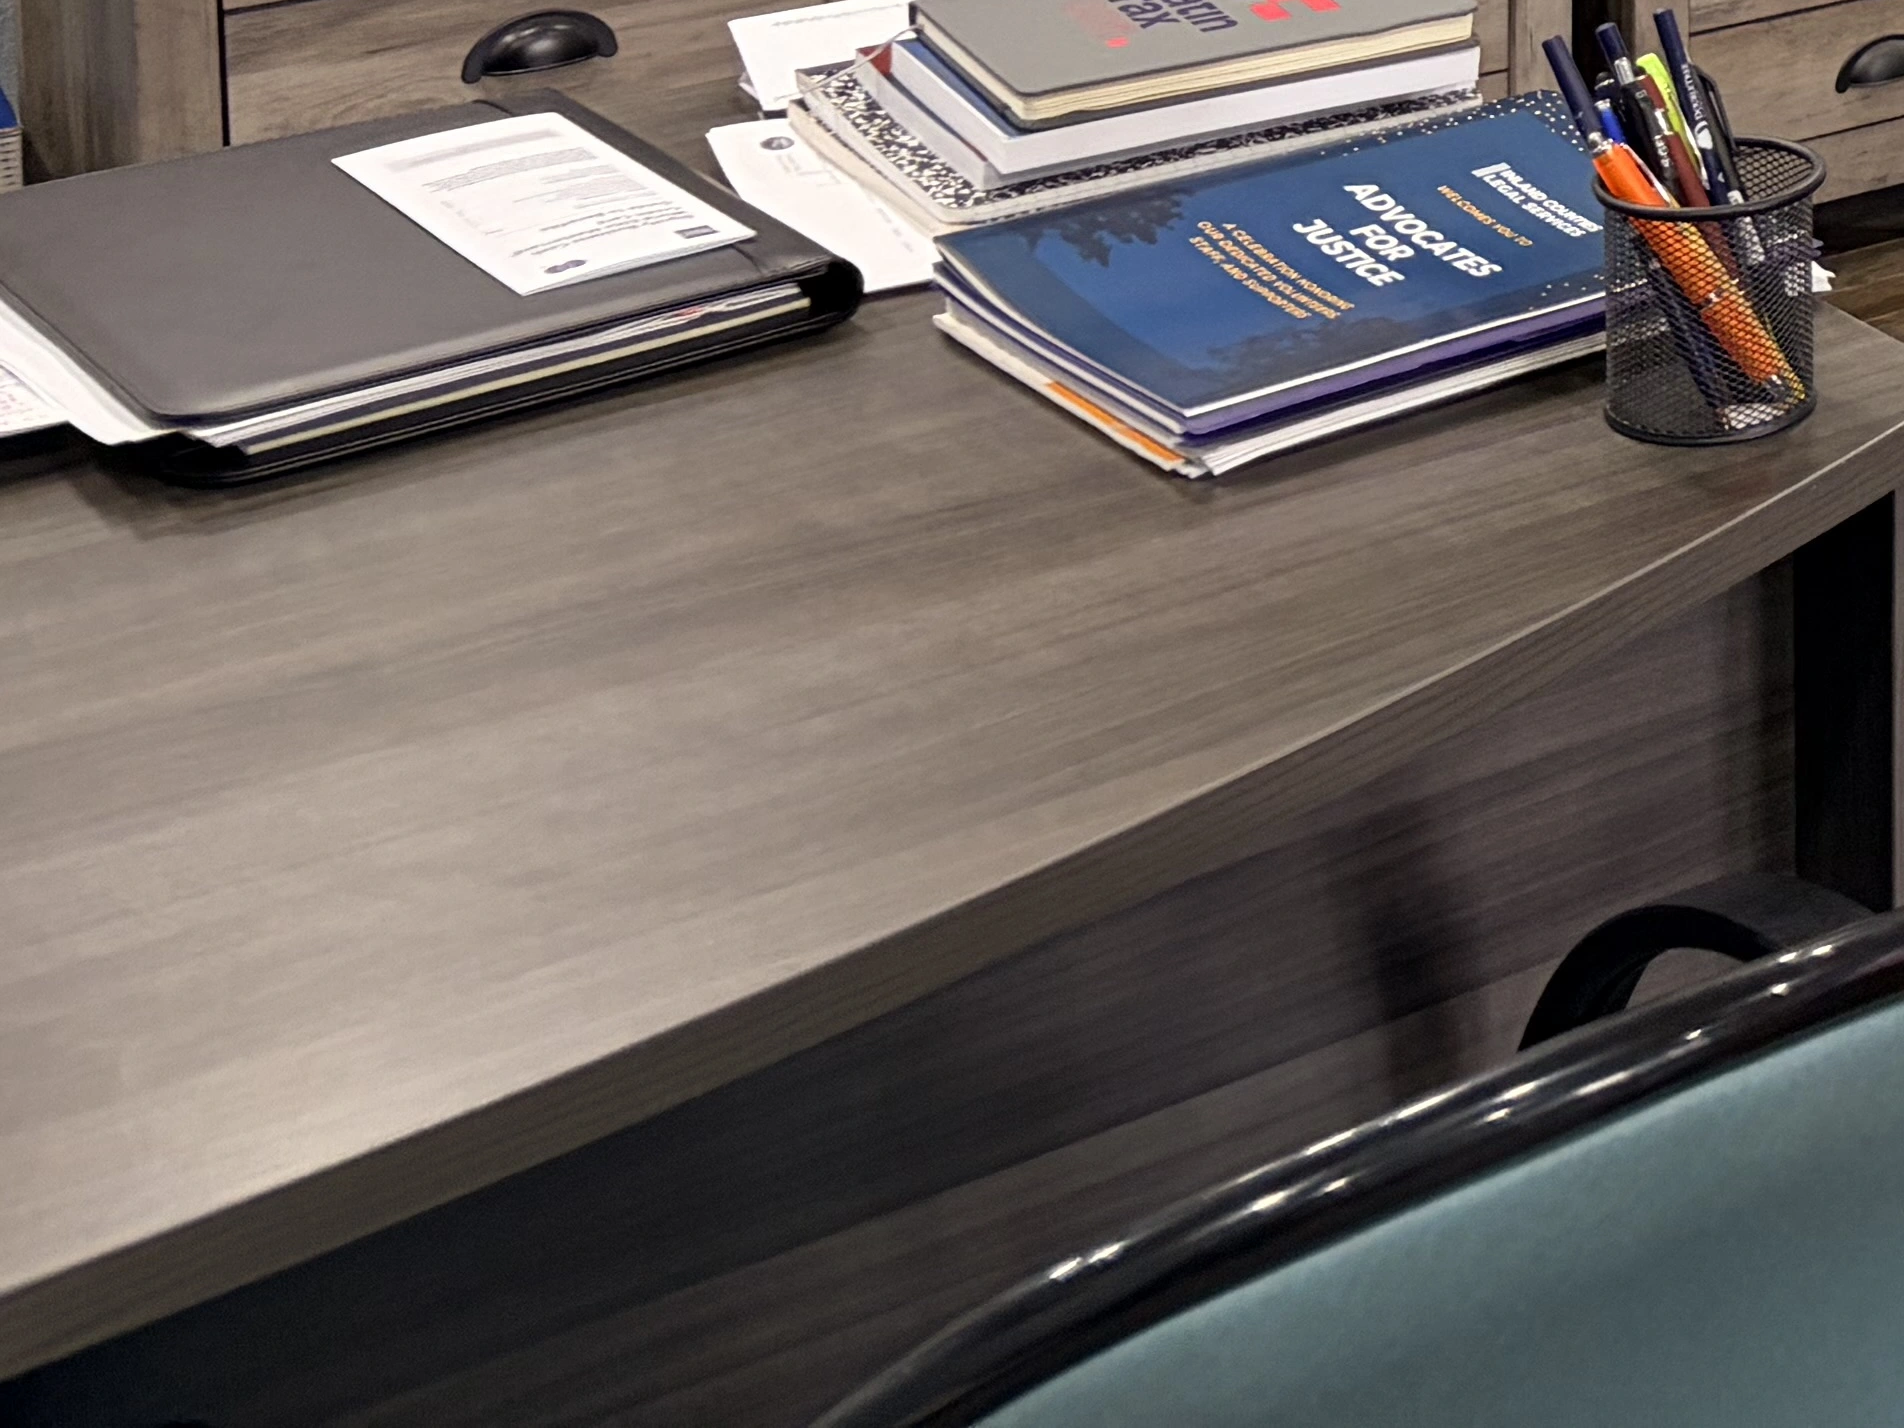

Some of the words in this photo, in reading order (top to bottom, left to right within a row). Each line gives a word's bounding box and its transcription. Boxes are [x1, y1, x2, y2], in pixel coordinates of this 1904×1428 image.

[1343, 183, 1502, 278] ADVOCATES
[1436, 185, 1494, 227] WELCOMES
[1491, 220, 1517, 239] YOU
[1513, 233, 1534, 247] TO
[1483, 173, 1523, 206] LEGAL
[1521, 201, 1587, 238] SERVICES
[1502, 168, 1547, 203] INLAND
[1542, 195, 1604, 233] COUNTIES
[1189, 235, 1222, 265] STAFF,
[1218, 261, 1247, 282] AND
[1242, 277, 1312, 319] SUPPORTERS
[1197, 220, 1225, 239] OUR
[1217, 238, 1277, 283] DEDICATED
[1273, 279, 1341, 319] VOLUNTEERS
[1232, 228, 1300, 280] CELEBRATION
[1298, 275, 1355, 312] HONORING
[1293, 219, 1405, 288] JUSTICE
[1348, 224, 1416, 263] FOR
